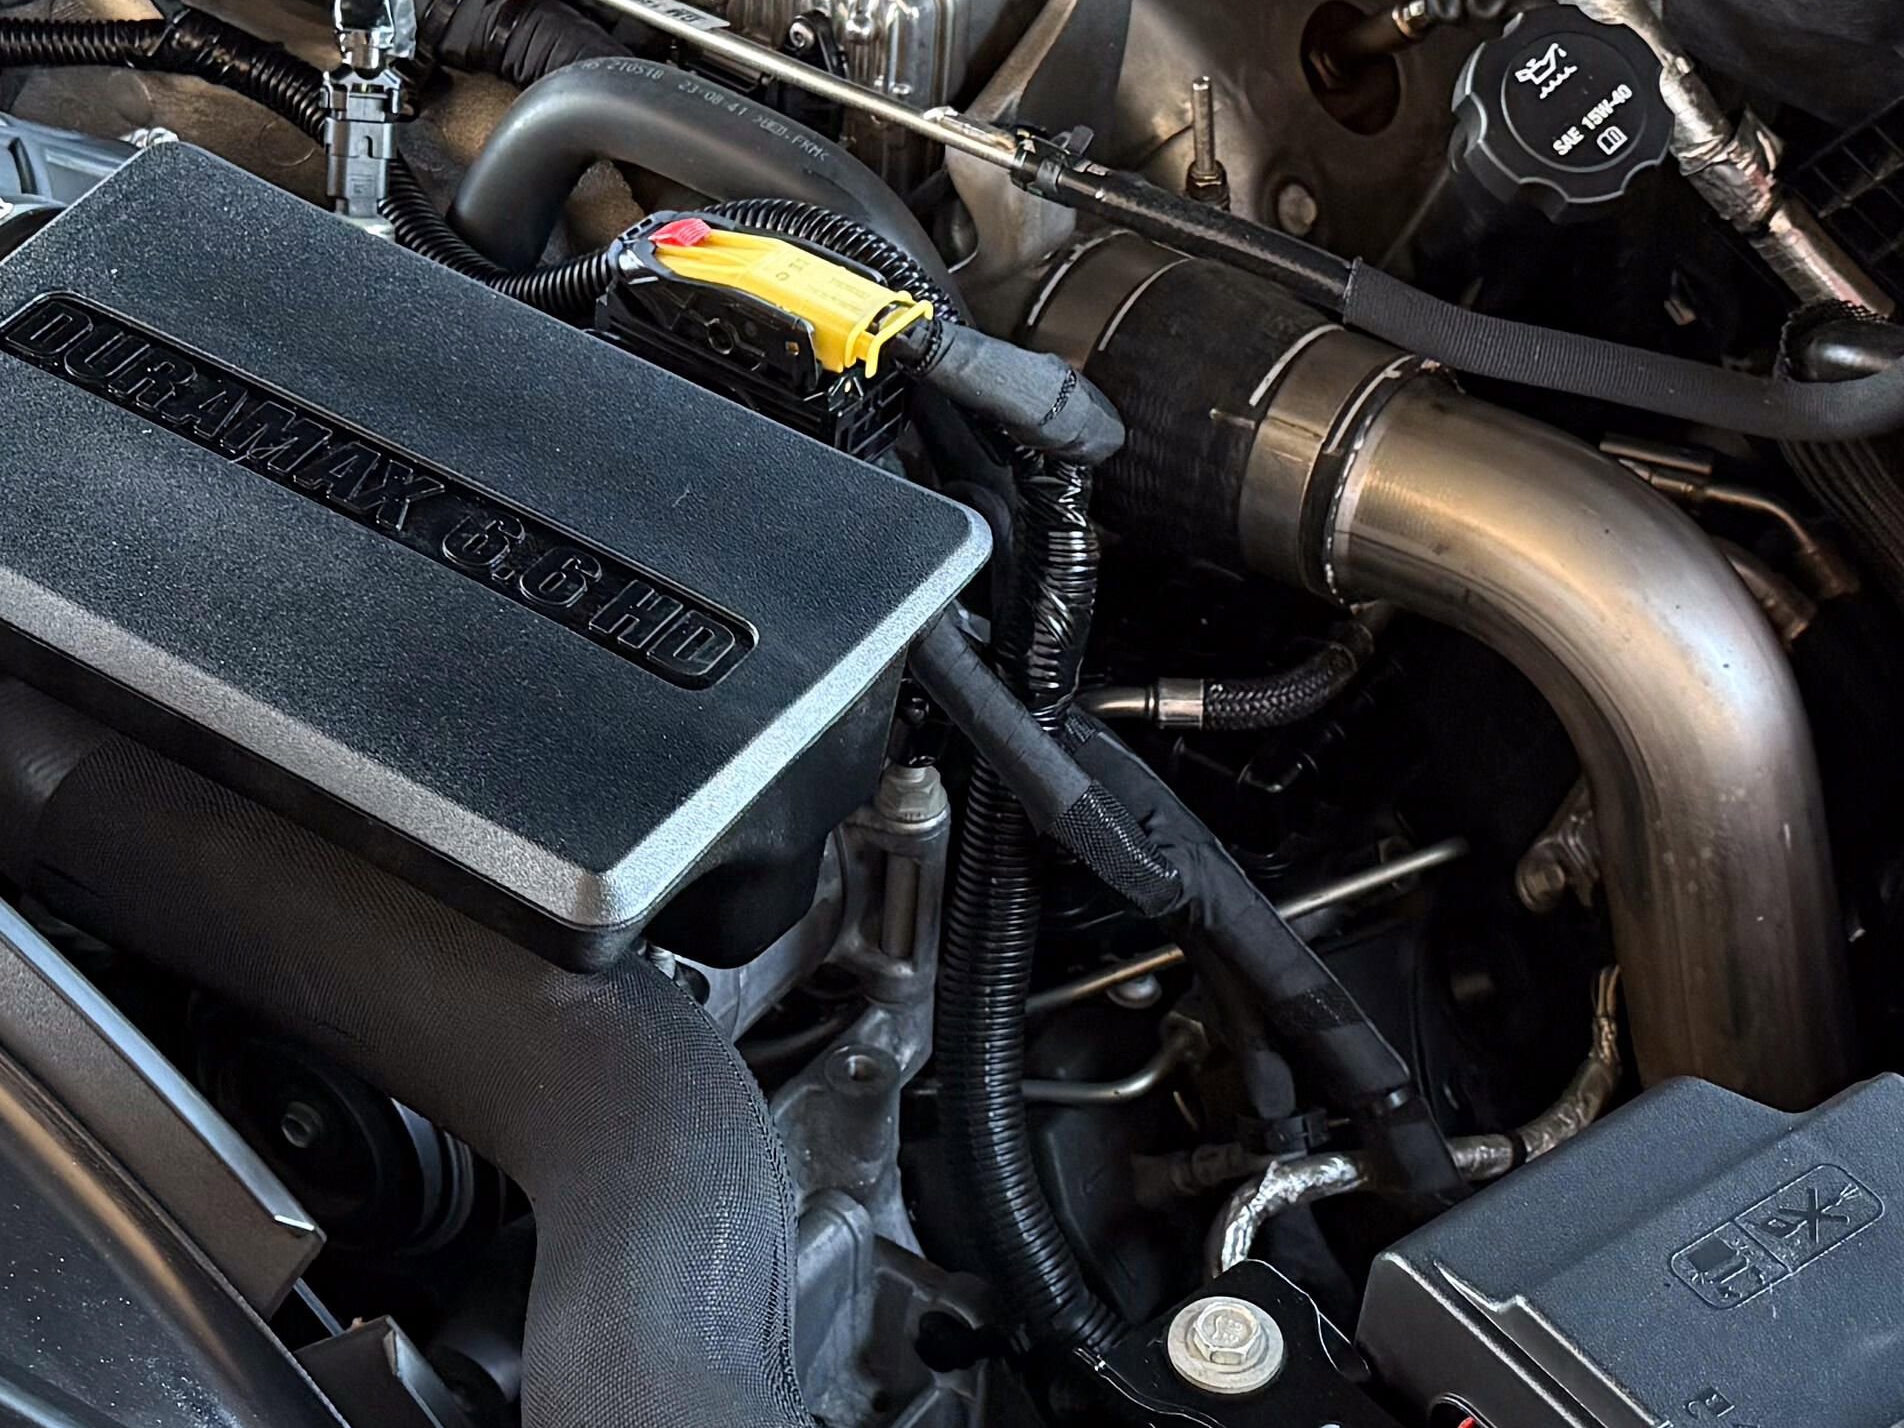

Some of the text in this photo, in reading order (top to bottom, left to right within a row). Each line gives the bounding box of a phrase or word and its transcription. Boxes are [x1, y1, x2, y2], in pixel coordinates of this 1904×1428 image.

[1553, 84, 1633, 155] SAE 15W-40
[2, 298, 736, 675] DURAMAX 6.6 HD
